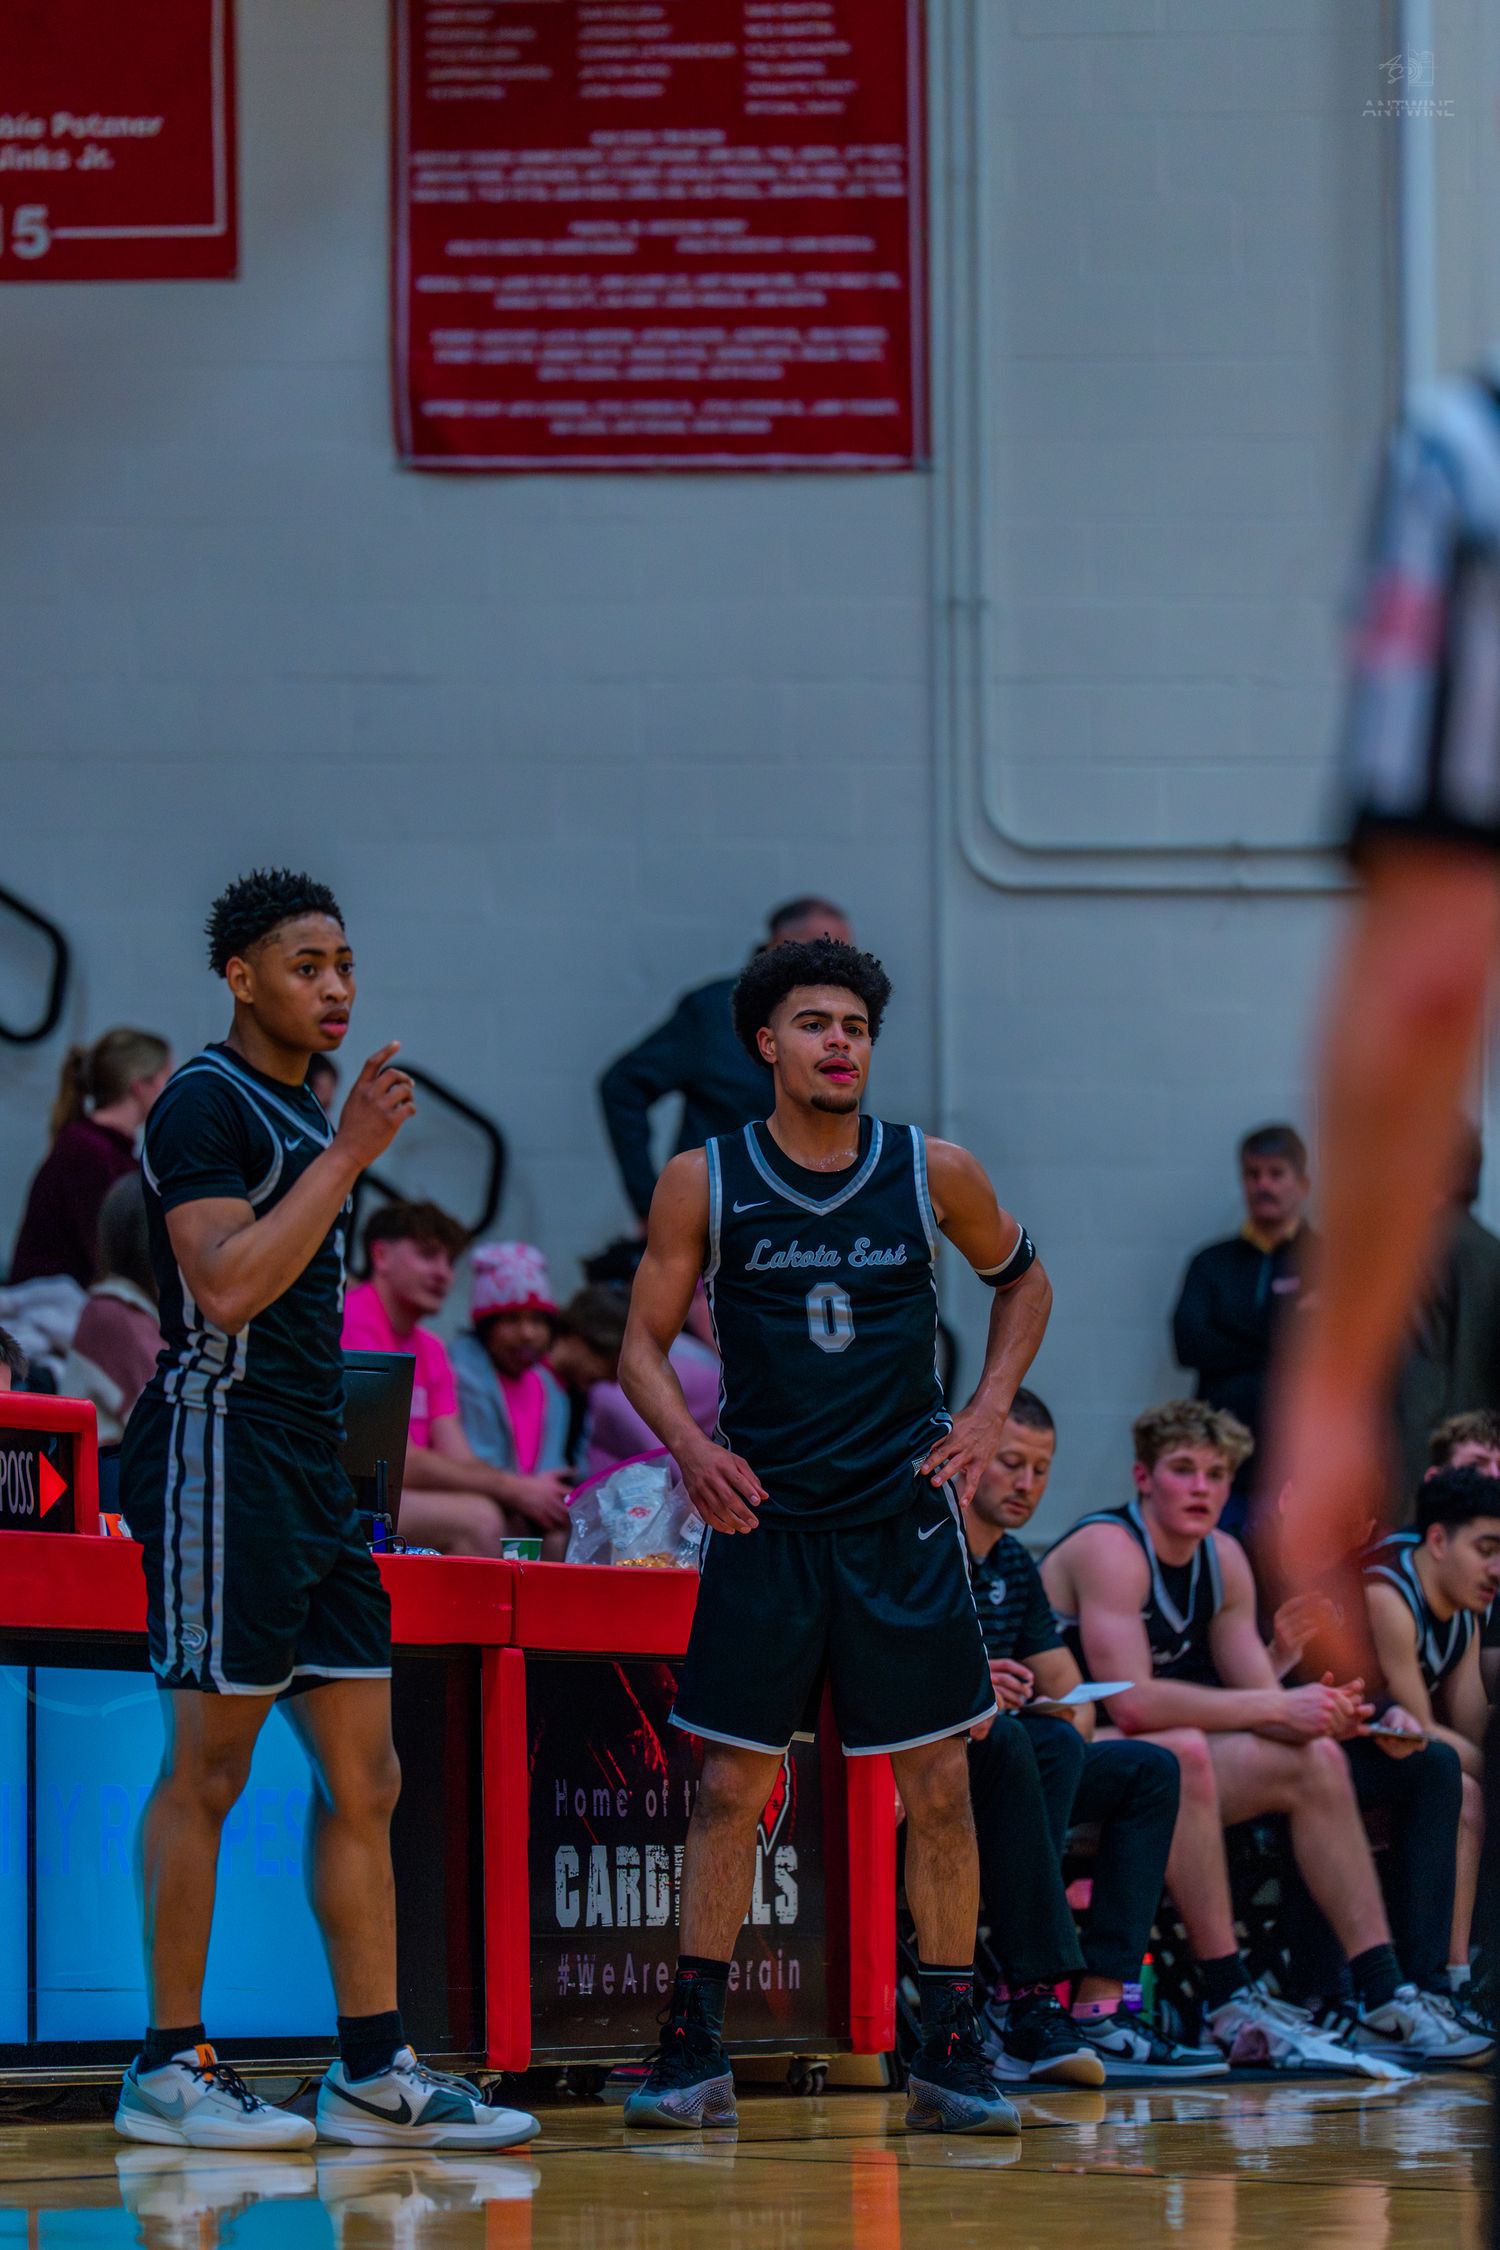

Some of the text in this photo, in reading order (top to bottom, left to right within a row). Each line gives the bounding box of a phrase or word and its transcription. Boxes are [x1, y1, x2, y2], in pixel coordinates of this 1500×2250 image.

[76, 143, 116, 171] Jr.
[745, 1236, 907, 1271] Lakota East
[805, 1281, 856, 1353] 0
[555, 1778, 630, 1818] Home
[645, 1779, 669, 1818] of
